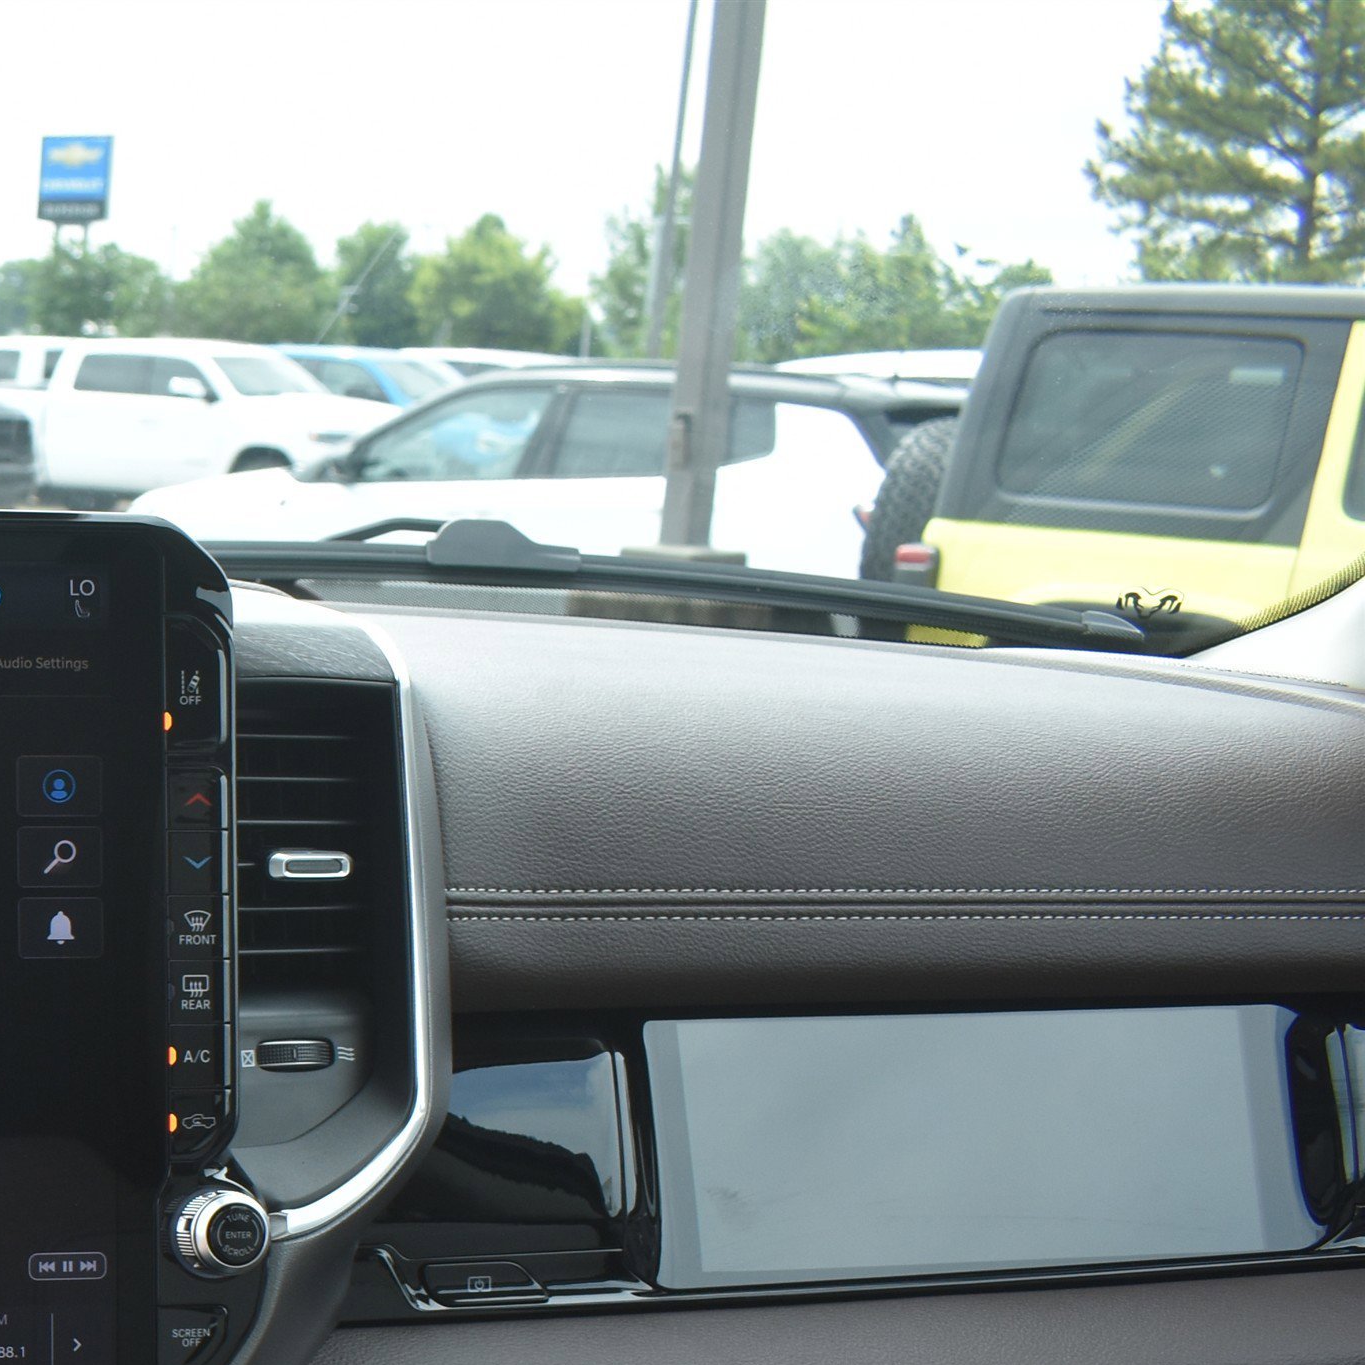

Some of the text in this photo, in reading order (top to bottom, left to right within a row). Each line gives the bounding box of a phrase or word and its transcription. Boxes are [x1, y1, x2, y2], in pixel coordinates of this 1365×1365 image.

[70, 579, 95, 596] LO
[35, 656, 89, 671] Settings
[179, 695, 202, 706] OFF
[179, 934, 217, 945] FRONT
[181, 1000, 211, 1010] REAR
[183, 1050, 211, 1063] A/C
[226, 1213, 251, 1223] TUNE
[225, 1231, 252, 1239] ENTER
[222, 1245, 255, 1257] SCROLL
[172, 1328, 211, 1338] SCREEN
[181, 1338, 202, 1347] OFF
